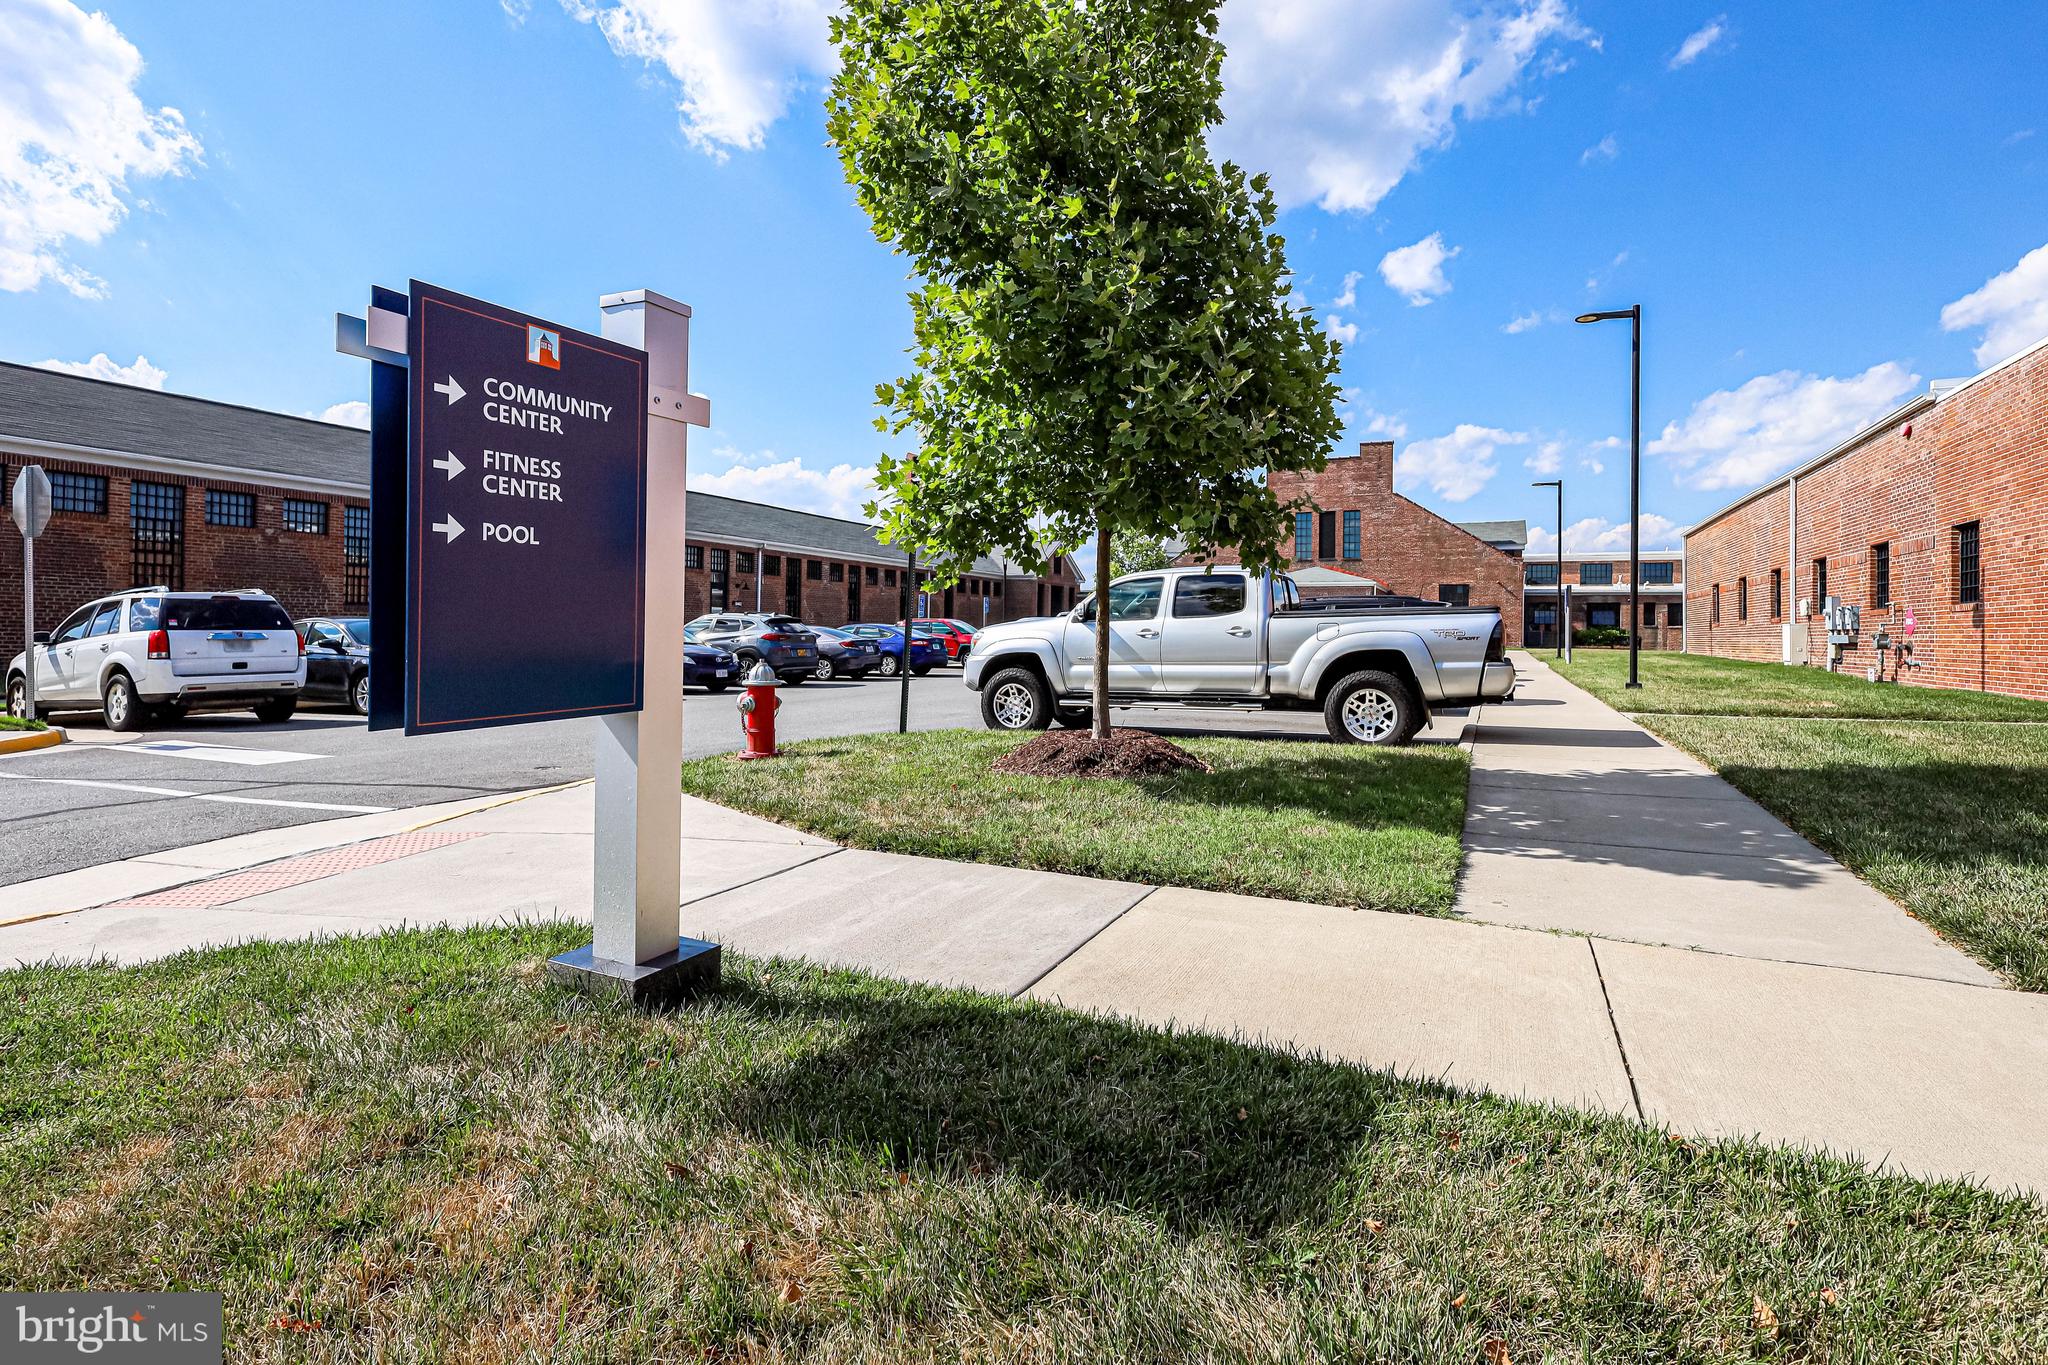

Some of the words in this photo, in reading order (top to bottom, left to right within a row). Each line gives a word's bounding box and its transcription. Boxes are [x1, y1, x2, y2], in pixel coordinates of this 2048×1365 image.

[483, 377, 613, 422] COMMUNITY
[483, 402, 564, 435] CENTER
[483, 449, 562, 479] FITNESS
[482, 474, 563, 502] CENTER
[482, 522, 540, 545] POOL
